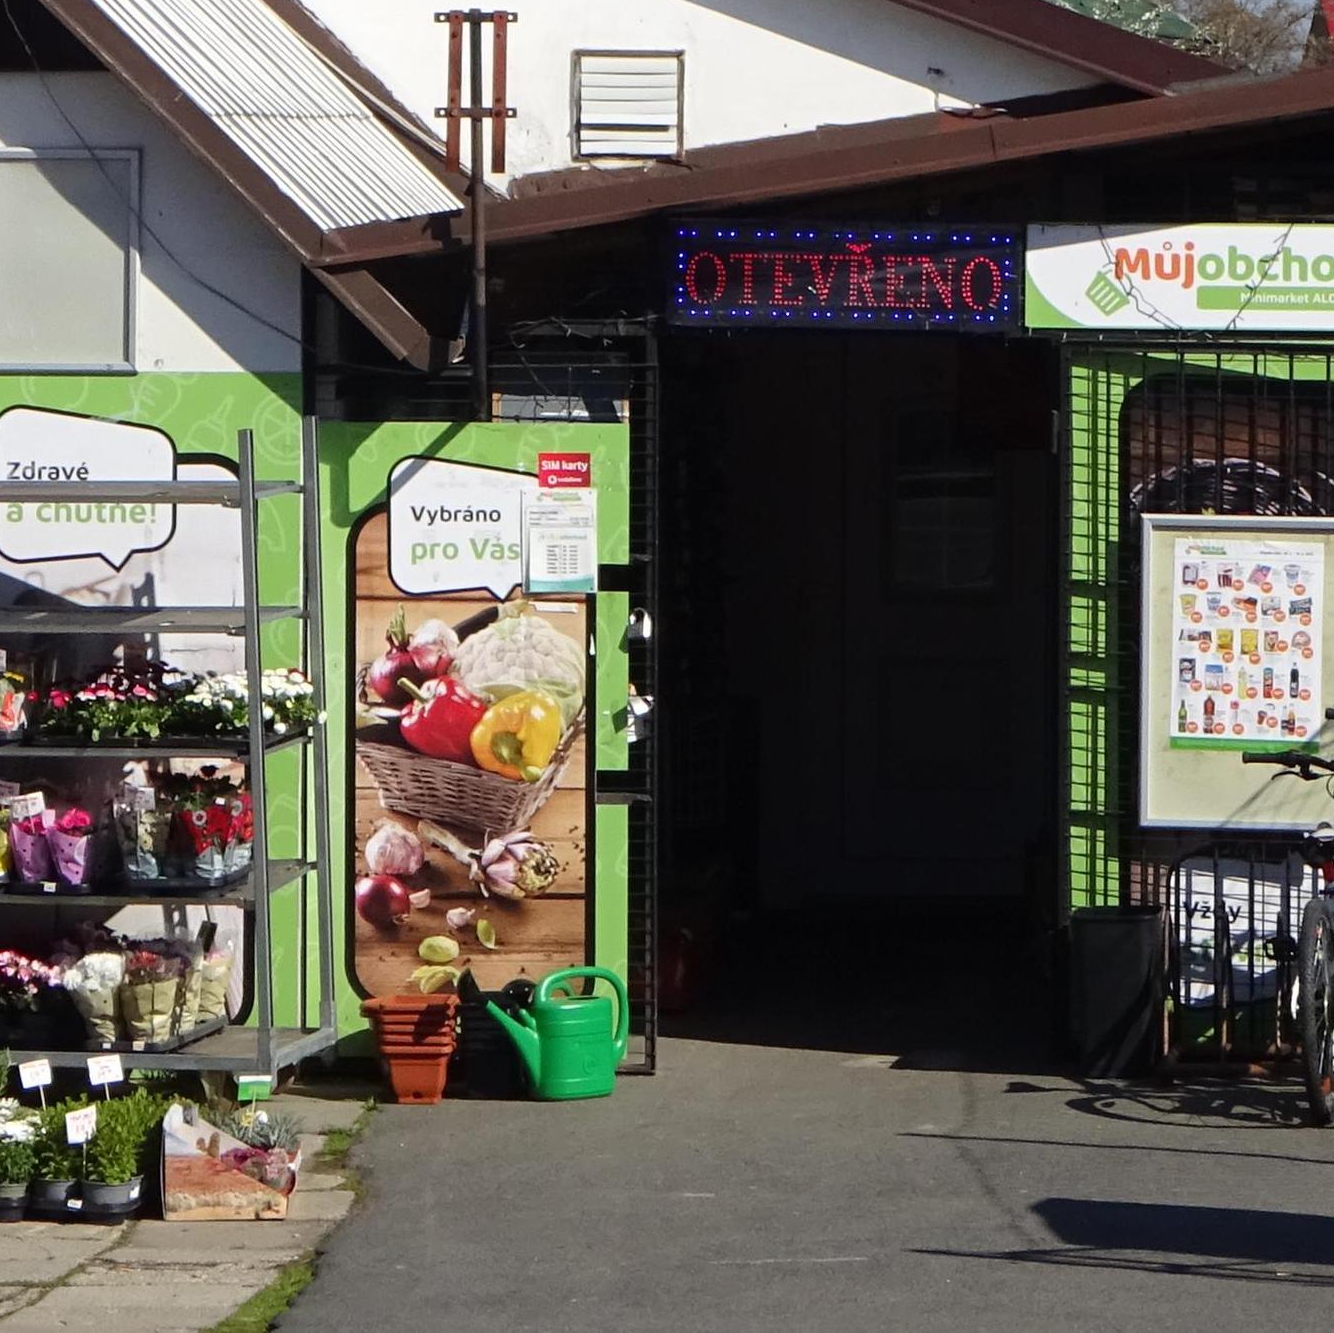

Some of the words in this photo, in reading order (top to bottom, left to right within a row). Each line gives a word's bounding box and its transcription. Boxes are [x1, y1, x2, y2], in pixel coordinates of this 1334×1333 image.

[685, 242, 1003, 311] OTEVŘENO
[6, 461, 89, 480] Zdravé
[541, 460, 560, 471] SIM
[562, 460, 588, 473] karty
[6, 503, 23, 522] a
[411, 505, 501, 526] Vybráno
[411, 541, 459, 565] pro
[1183, 901, 1241, 924] Vžy
